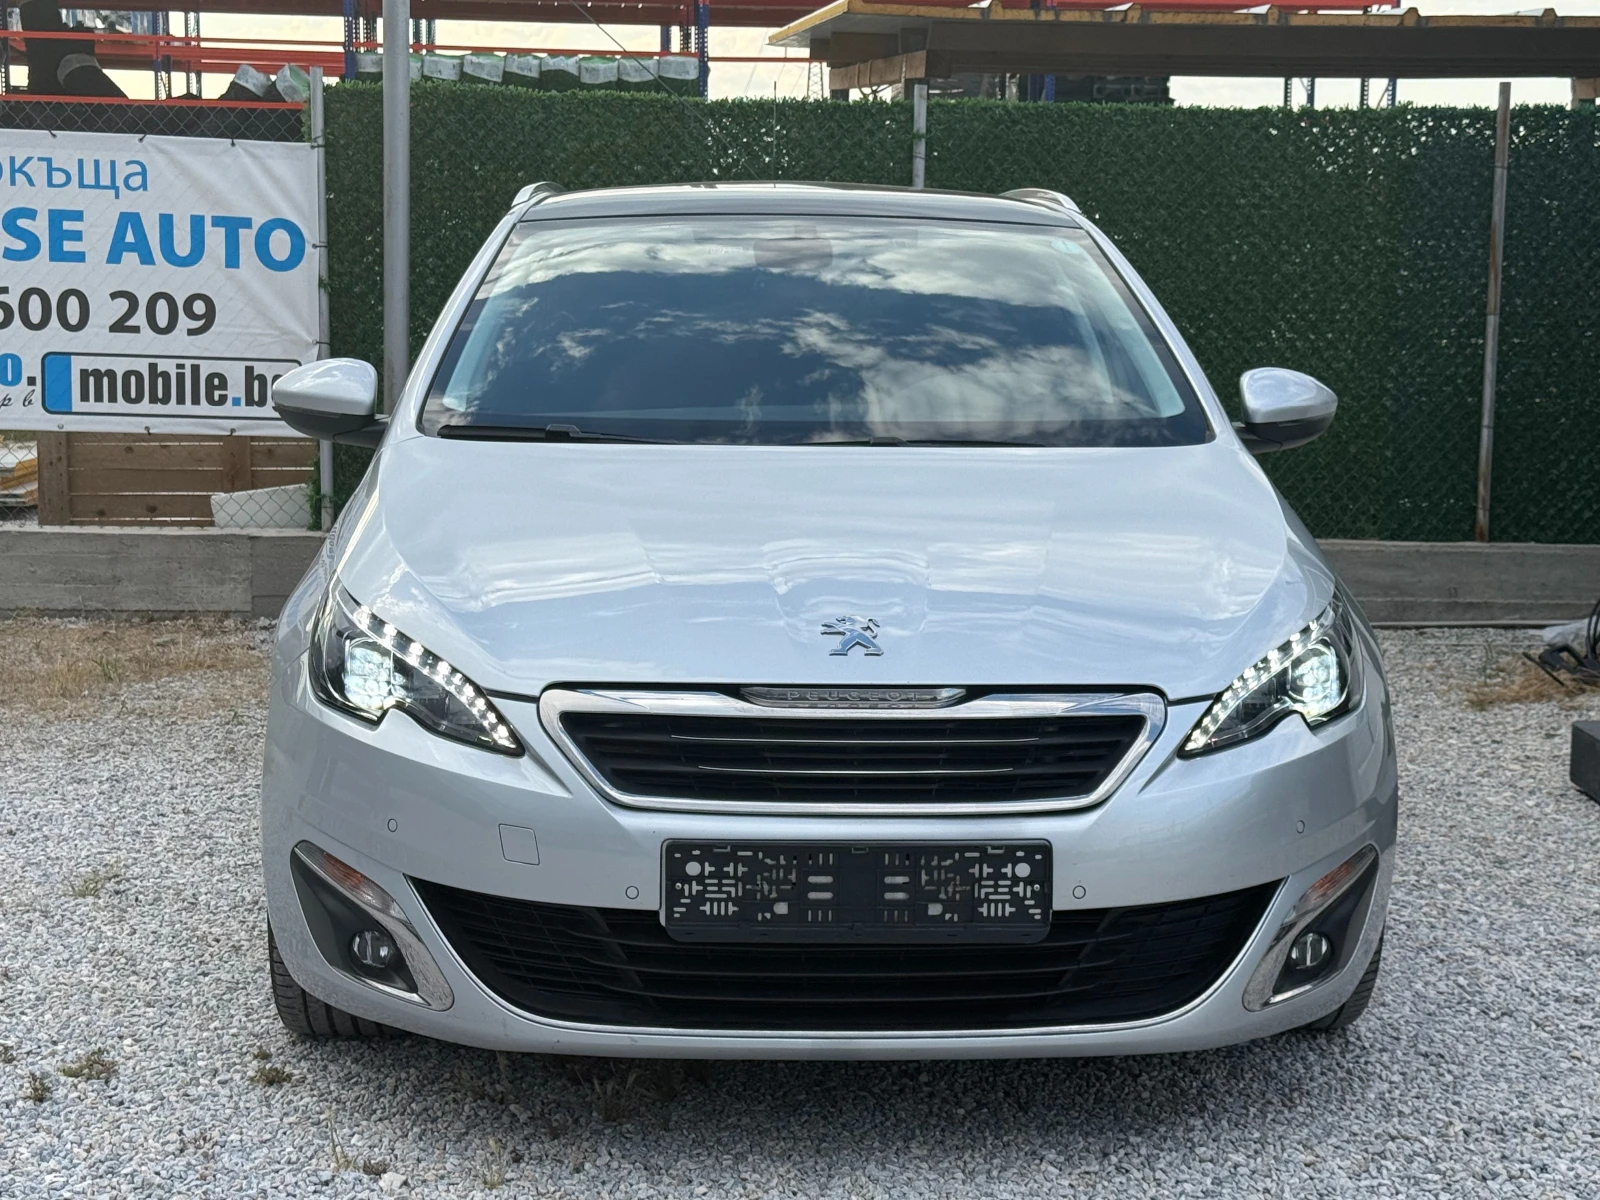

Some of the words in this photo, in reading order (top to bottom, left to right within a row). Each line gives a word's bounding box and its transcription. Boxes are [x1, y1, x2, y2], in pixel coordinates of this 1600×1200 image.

[0, 155, 149, 200] къща
[1, 206, 86, 264] SE
[105, 211, 306, 272] AUTO
[108, 290, 217, 337] 209
[79, 362, 283, 408] mobile.b
[786, 690, 923, 702] PEUGEOT
